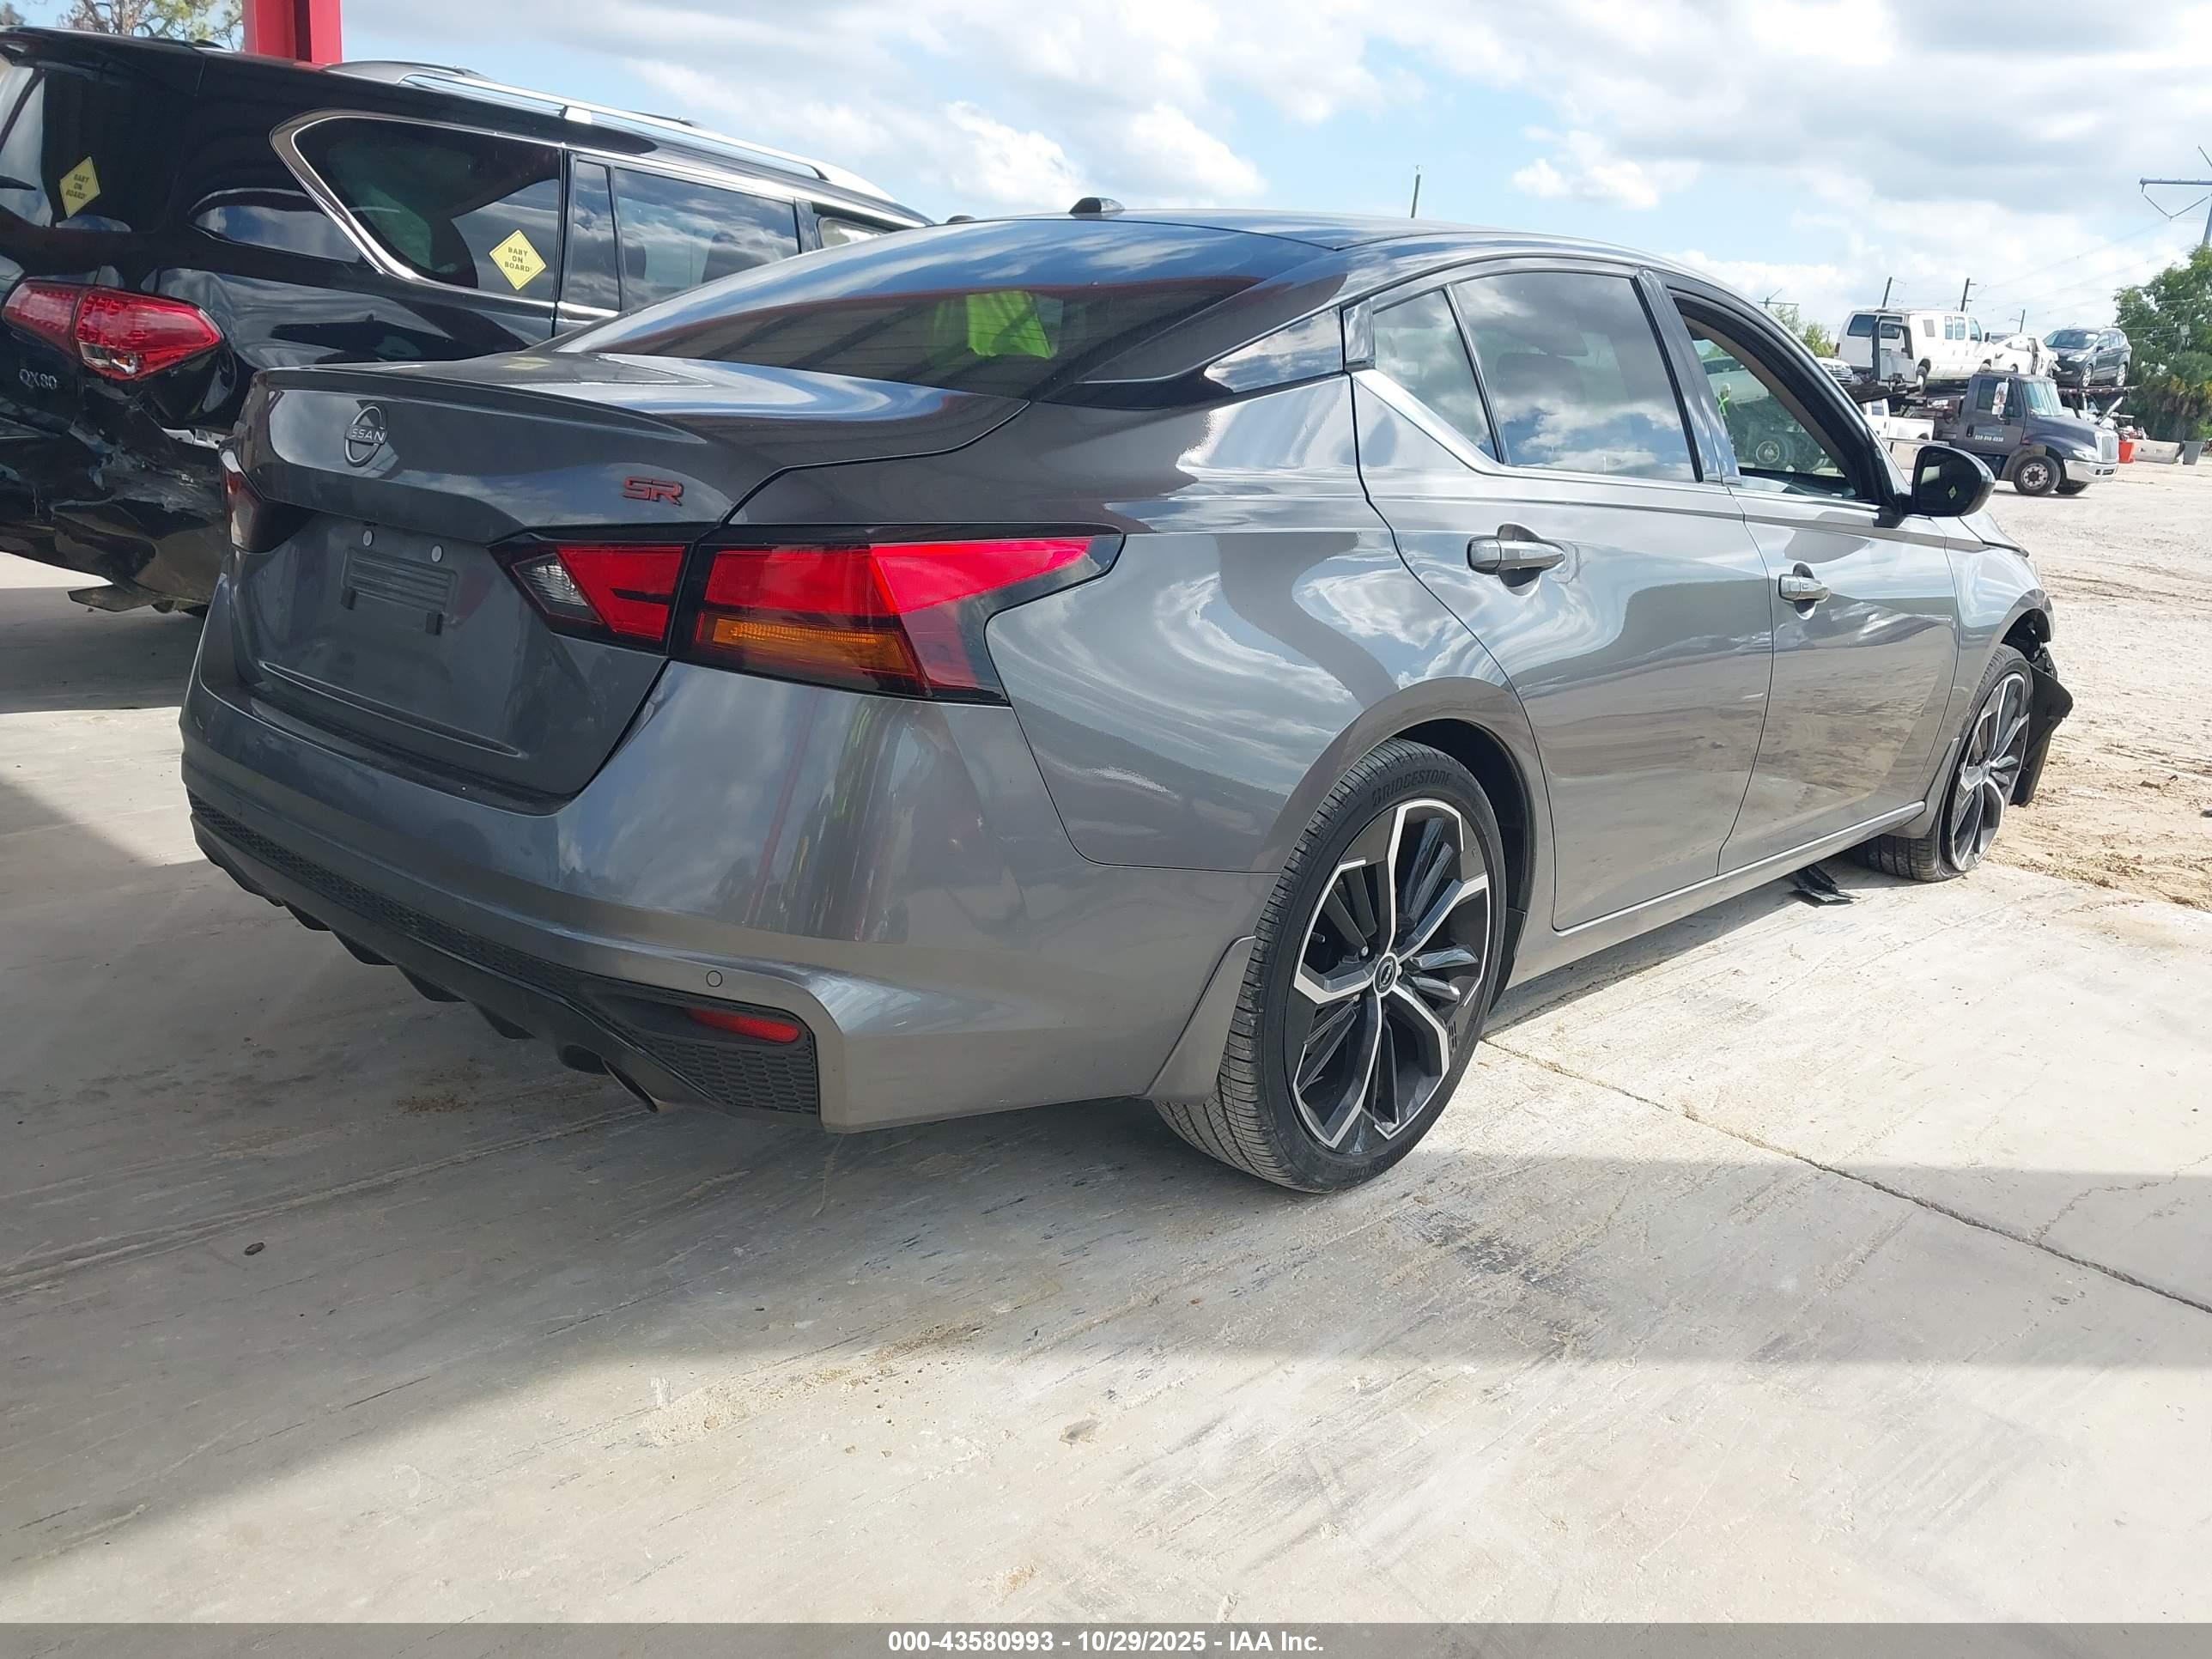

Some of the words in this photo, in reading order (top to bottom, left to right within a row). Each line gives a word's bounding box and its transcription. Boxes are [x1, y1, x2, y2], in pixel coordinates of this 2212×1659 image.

[74, 174, 89, 183] BABY
[74, 182, 83, 191] ON
[507, 246, 528, 256] BABY
[512, 255, 523, 264] ON
[19, 368, 57, 390] QX80
[623, 476, 684, 507] SR
[1372, 769, 1451, 805] BRIDGESTONE
